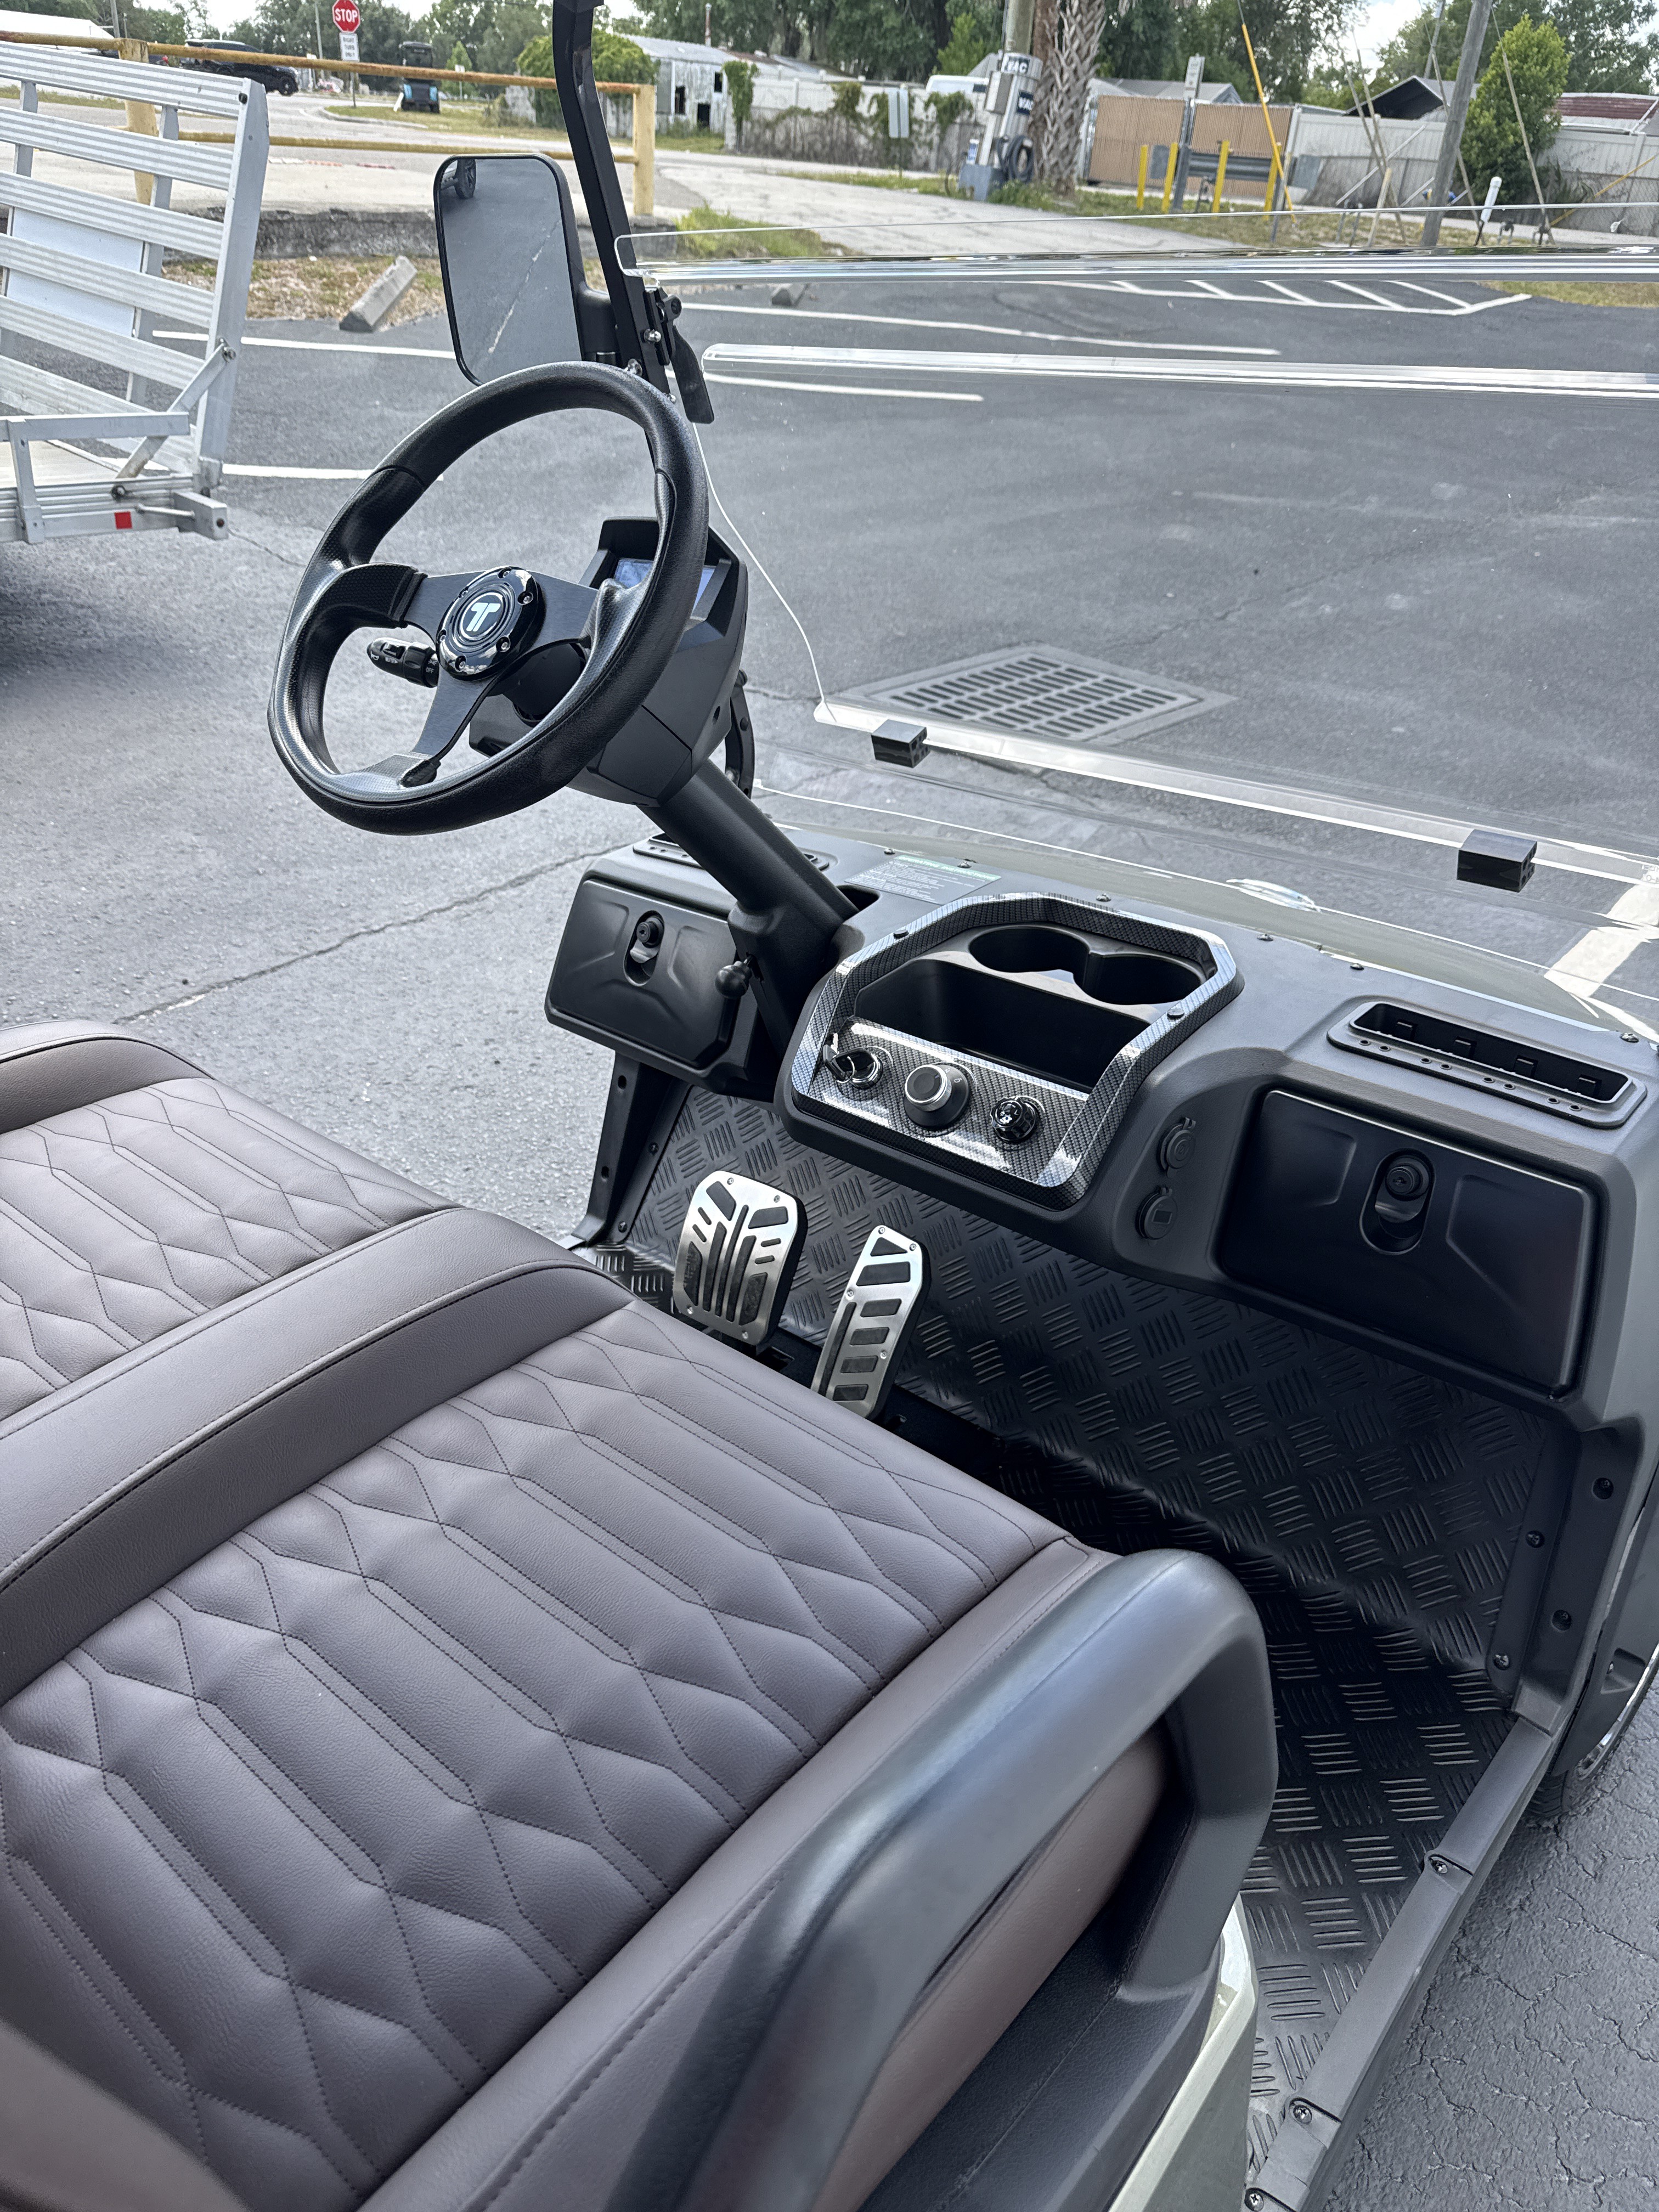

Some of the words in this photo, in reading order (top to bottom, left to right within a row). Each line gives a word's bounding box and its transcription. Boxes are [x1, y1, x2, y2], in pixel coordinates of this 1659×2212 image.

[335, 8, 358, 22] STOP
[1007, 60, 1028, 74] VAC
[466, 602, 501, 632] T
